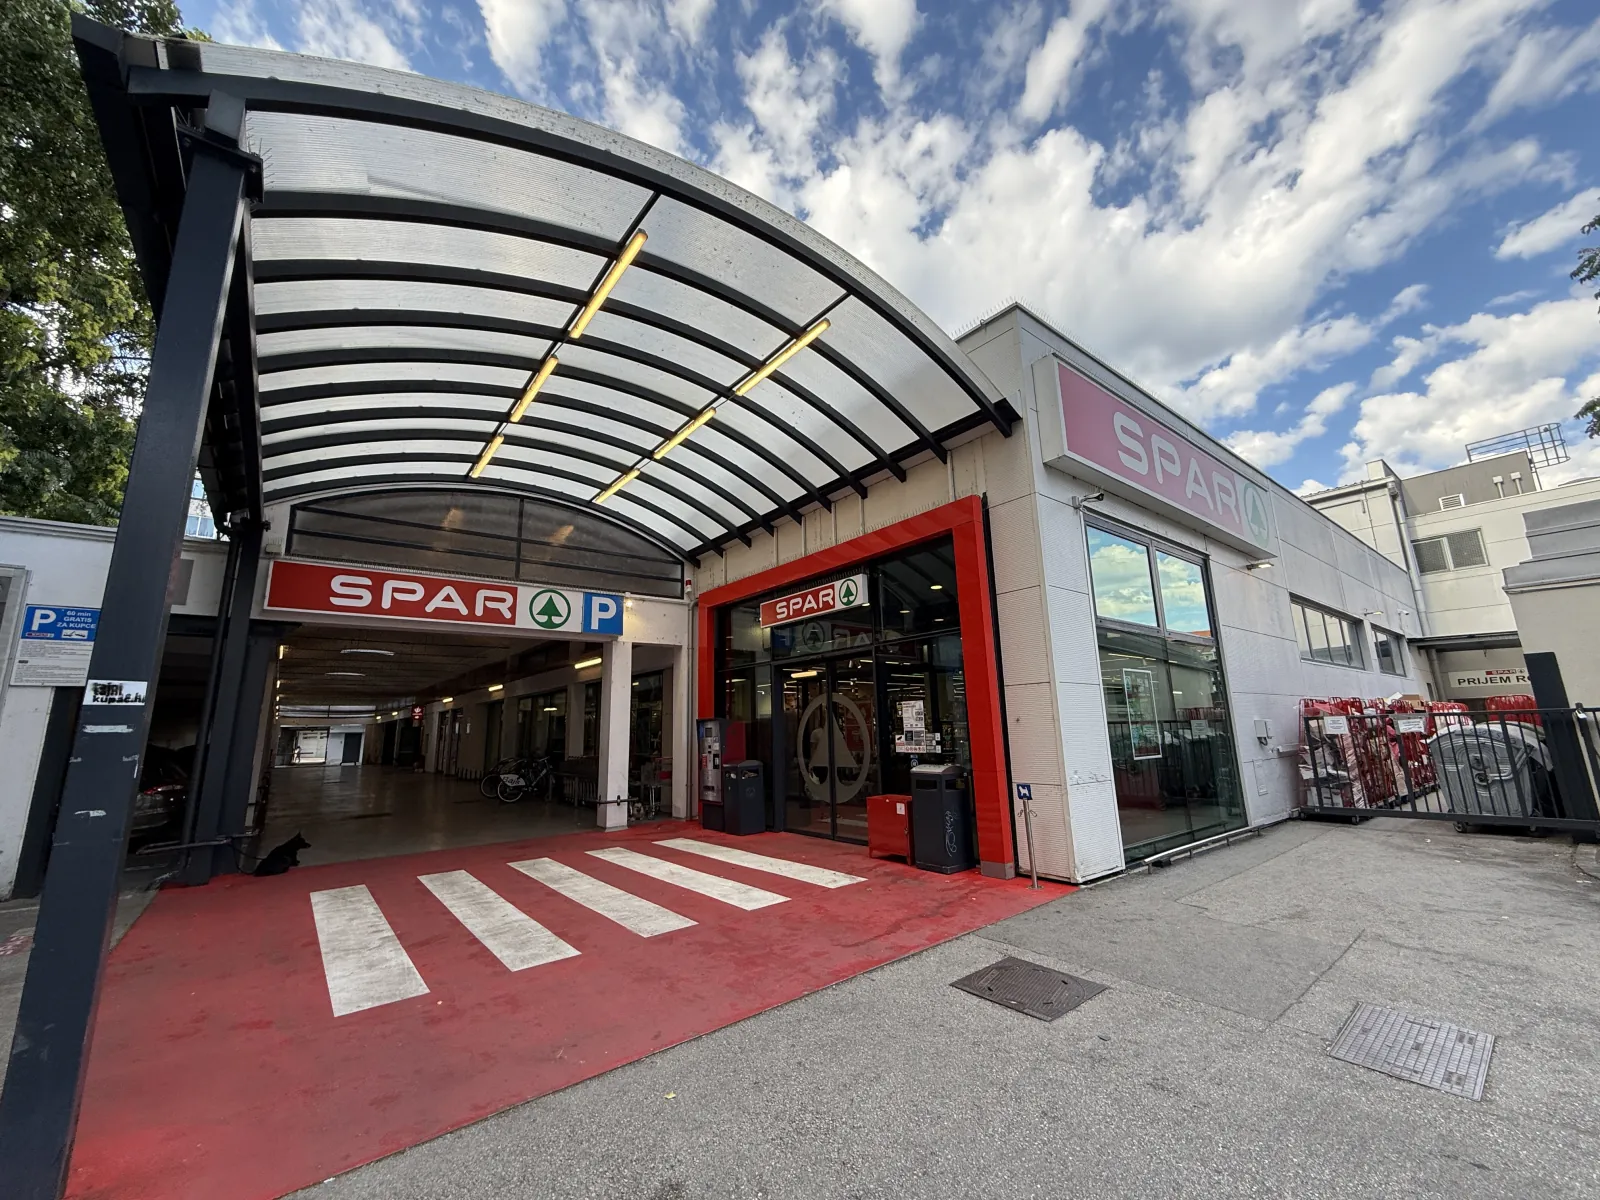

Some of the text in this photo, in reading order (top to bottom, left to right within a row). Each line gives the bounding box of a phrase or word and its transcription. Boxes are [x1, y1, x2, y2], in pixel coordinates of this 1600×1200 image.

[1113, 411, 1240, 523] SPAR
[329, 575, 514, 618] SPAR
[776, 588, 834, 619] SPAR
[31, 609, 56, 631] P
[590, 597, 617, 630] P
[1457, 676, 1512, 686] PRIJEM
